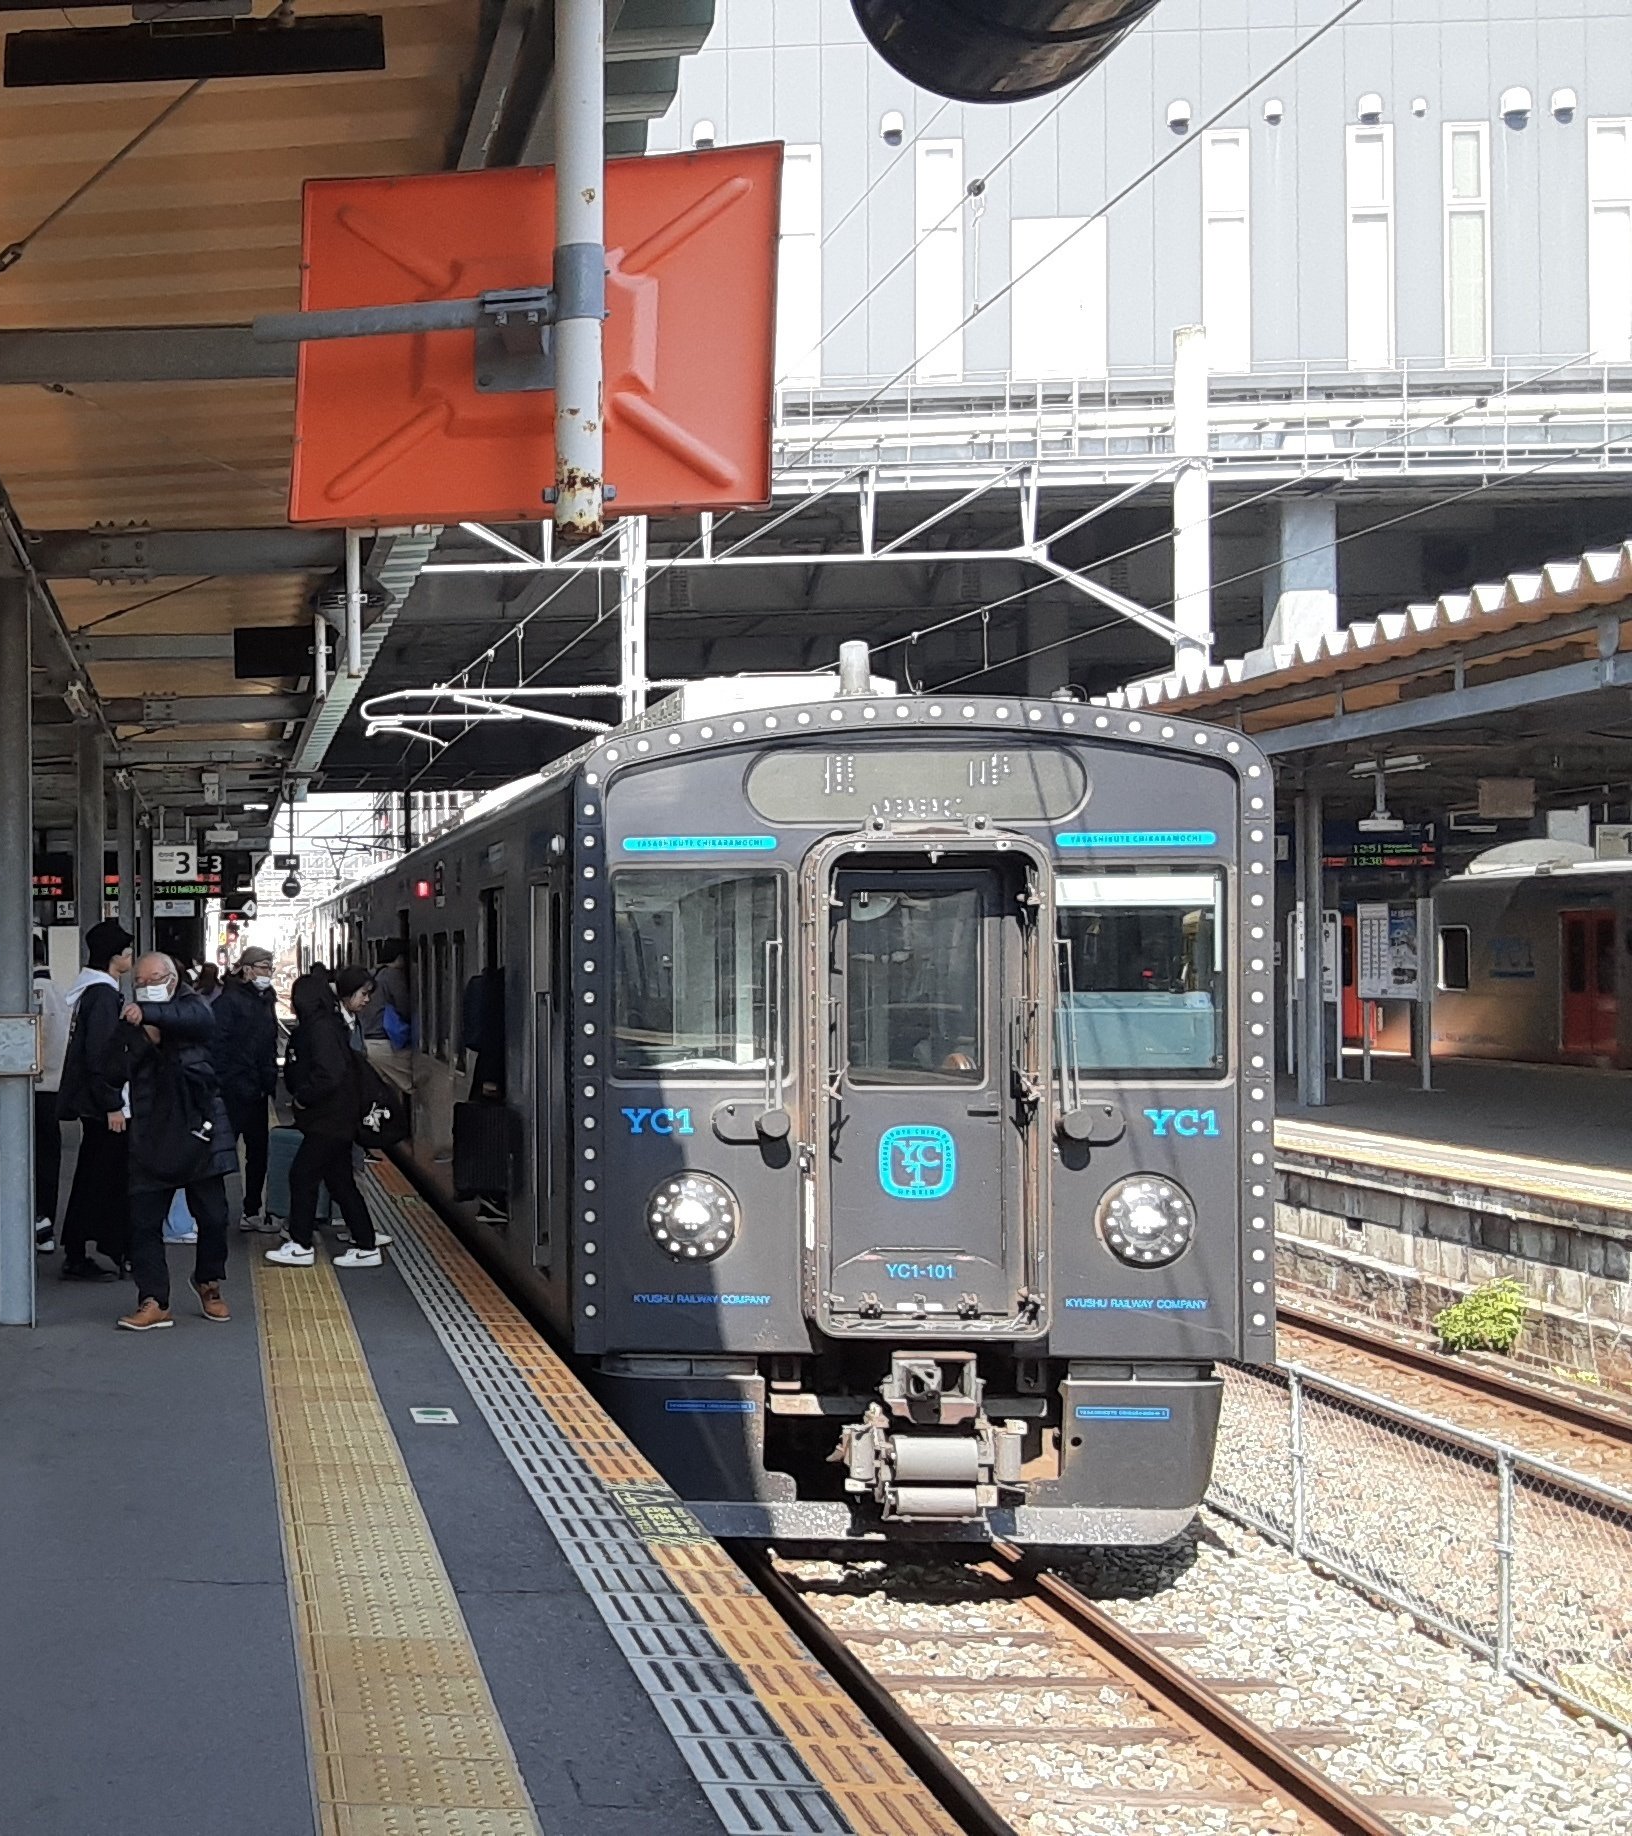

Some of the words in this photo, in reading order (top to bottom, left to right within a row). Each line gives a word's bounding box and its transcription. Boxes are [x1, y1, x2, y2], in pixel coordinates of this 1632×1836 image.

[1425, 823, 1435, 841] 1
[175, 851, 191, 875] 3
[210, 855, 222, 873] 3
[621, 1108, 694, 1134] YC1
[1143, 1109, 1220, 1136] YC1
[885, 1263, 953, 1279] YC1-101
[633, 1294, 674, 1303] KYUSHU
[676, 1294, 718, 1303] RAILWAY
[721, 1295, 771, 1305] COMPANY
[1065, 1298, 1108, 1308] KYUSHU
[1110, 1298, 1154, 1309] RAILWAY
[1156, 1299, 1208, 1310] COMPANY
